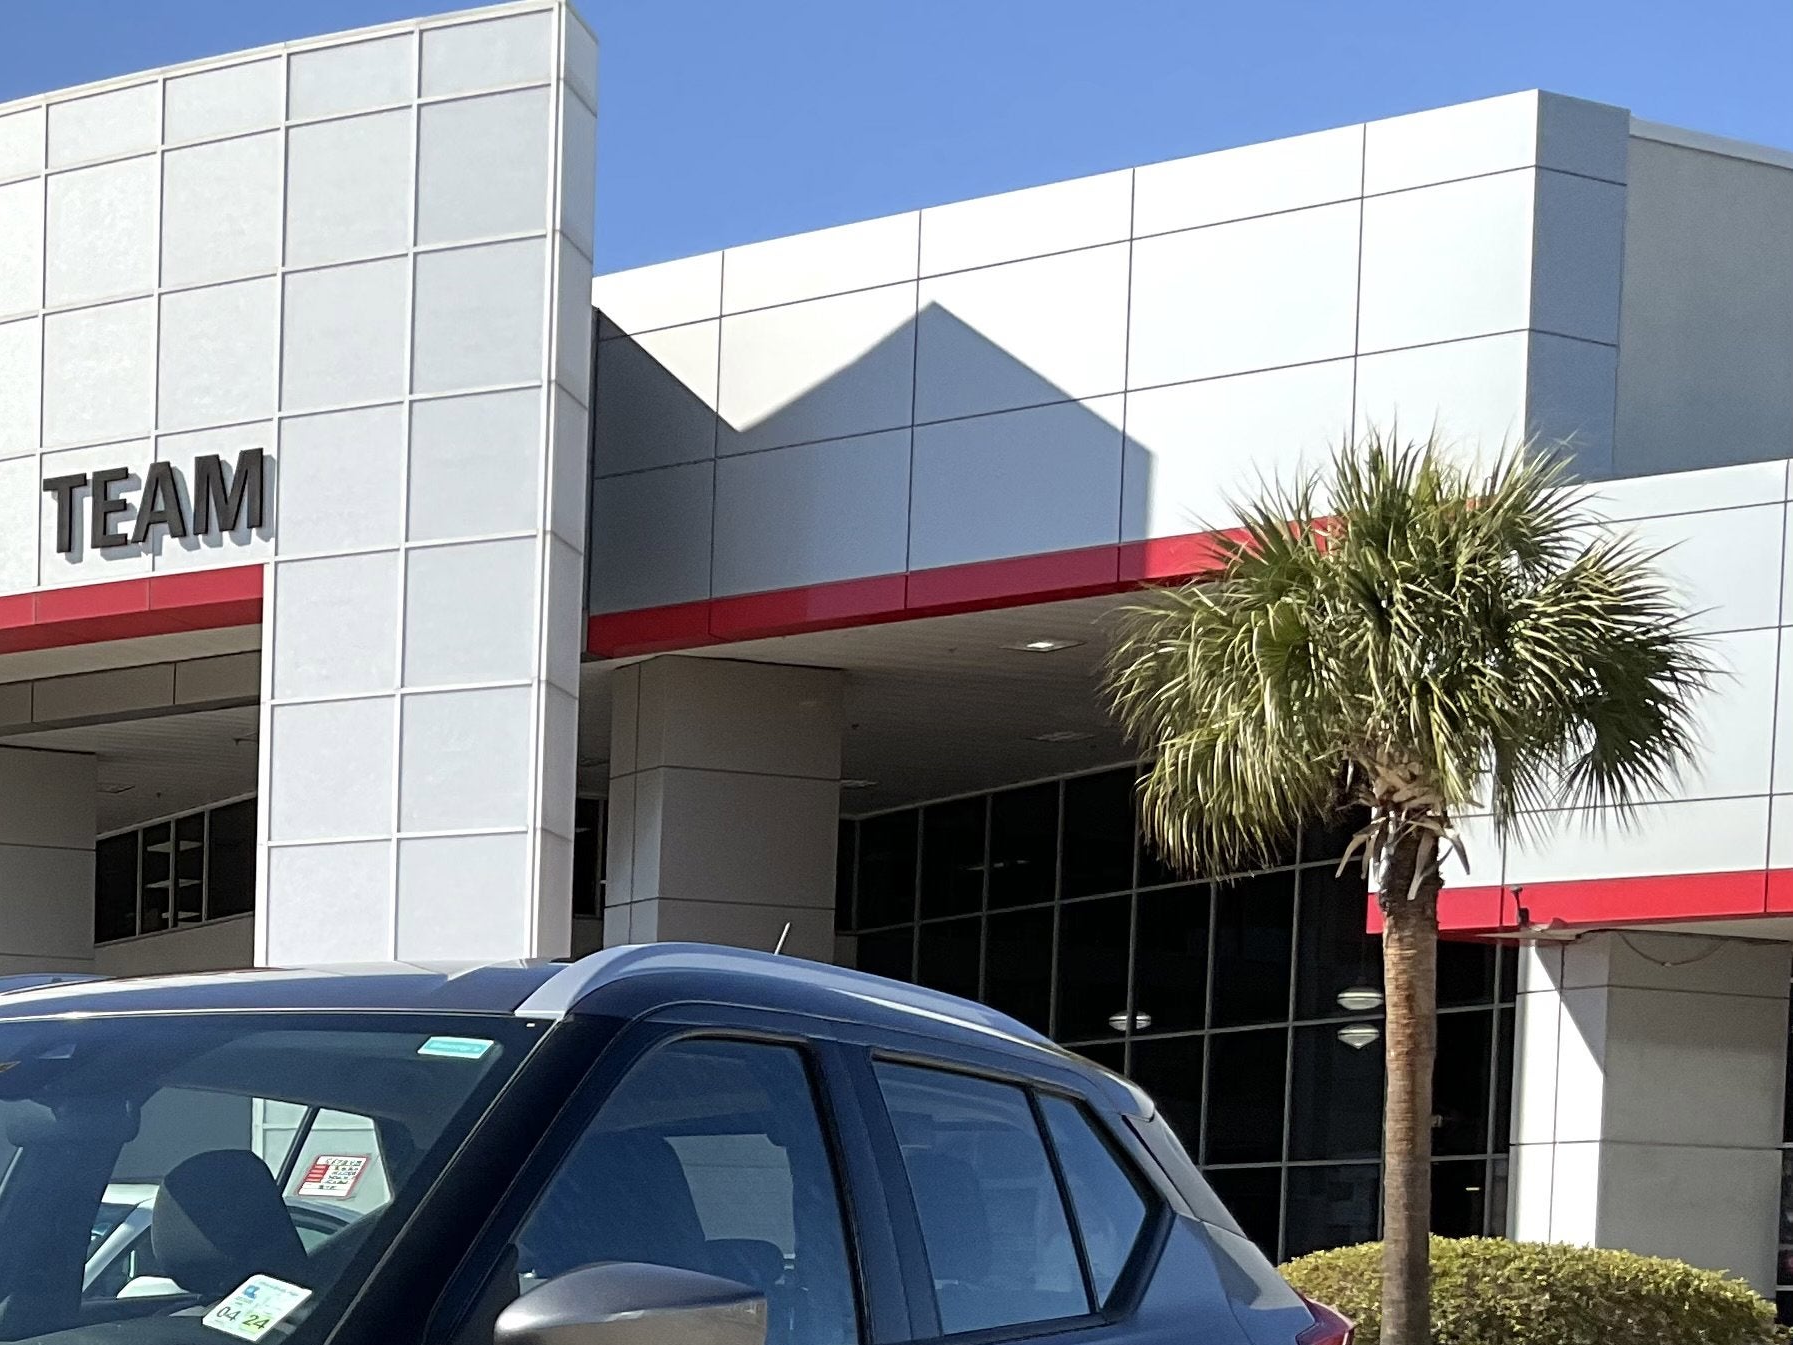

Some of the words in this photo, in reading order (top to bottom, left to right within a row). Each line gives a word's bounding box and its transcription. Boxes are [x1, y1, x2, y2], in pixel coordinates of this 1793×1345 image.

[43, 447, 264, 553] TEAM
[216, 1306, 242, 1321] 04
[242, 1314, 270, 1330] 24
